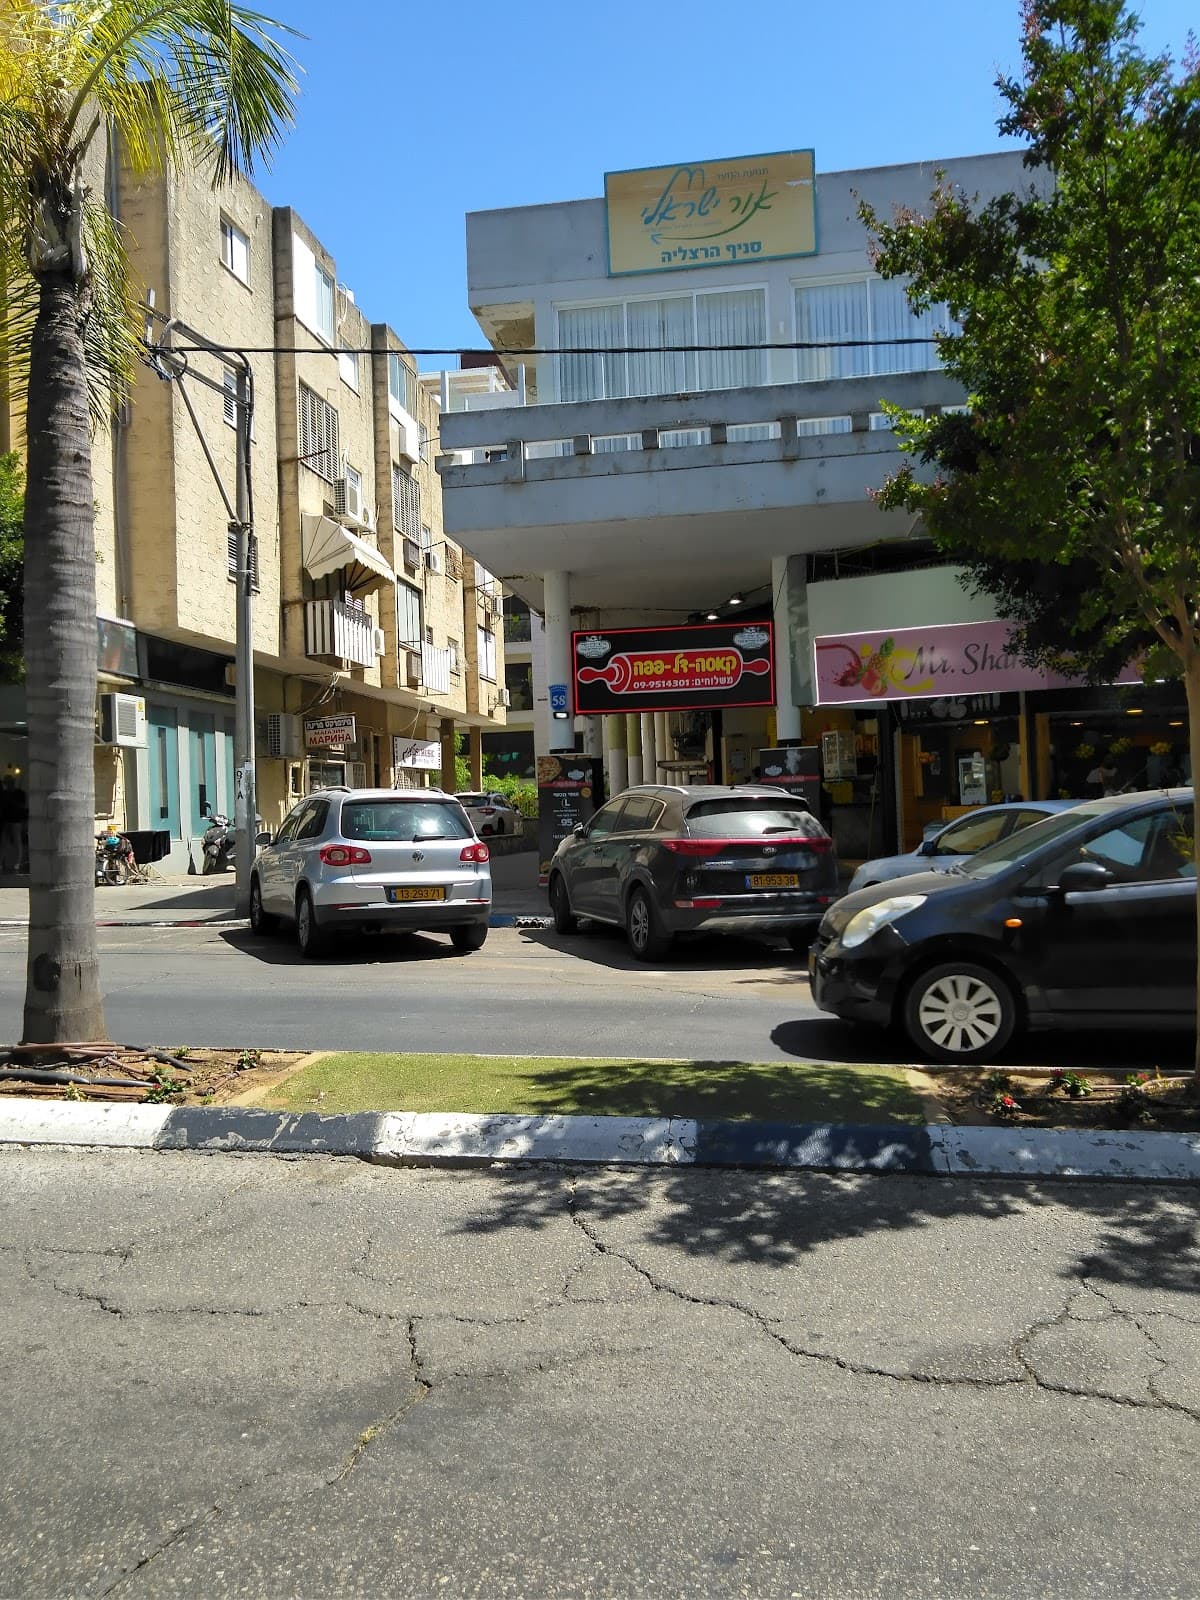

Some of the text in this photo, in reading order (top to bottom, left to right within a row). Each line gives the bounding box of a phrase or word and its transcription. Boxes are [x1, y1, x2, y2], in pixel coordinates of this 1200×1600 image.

[640, 167, 722, 226] ישראלי
[660, 241, 763, 263] סניף הרצליה
[903, 645, 955, 681] Mr.
[633, 675, 734, 689] משלוחים: 09-9514301
[552, 695, 565, 706] 58
[310, 733, 352, 745] МАРИНА
